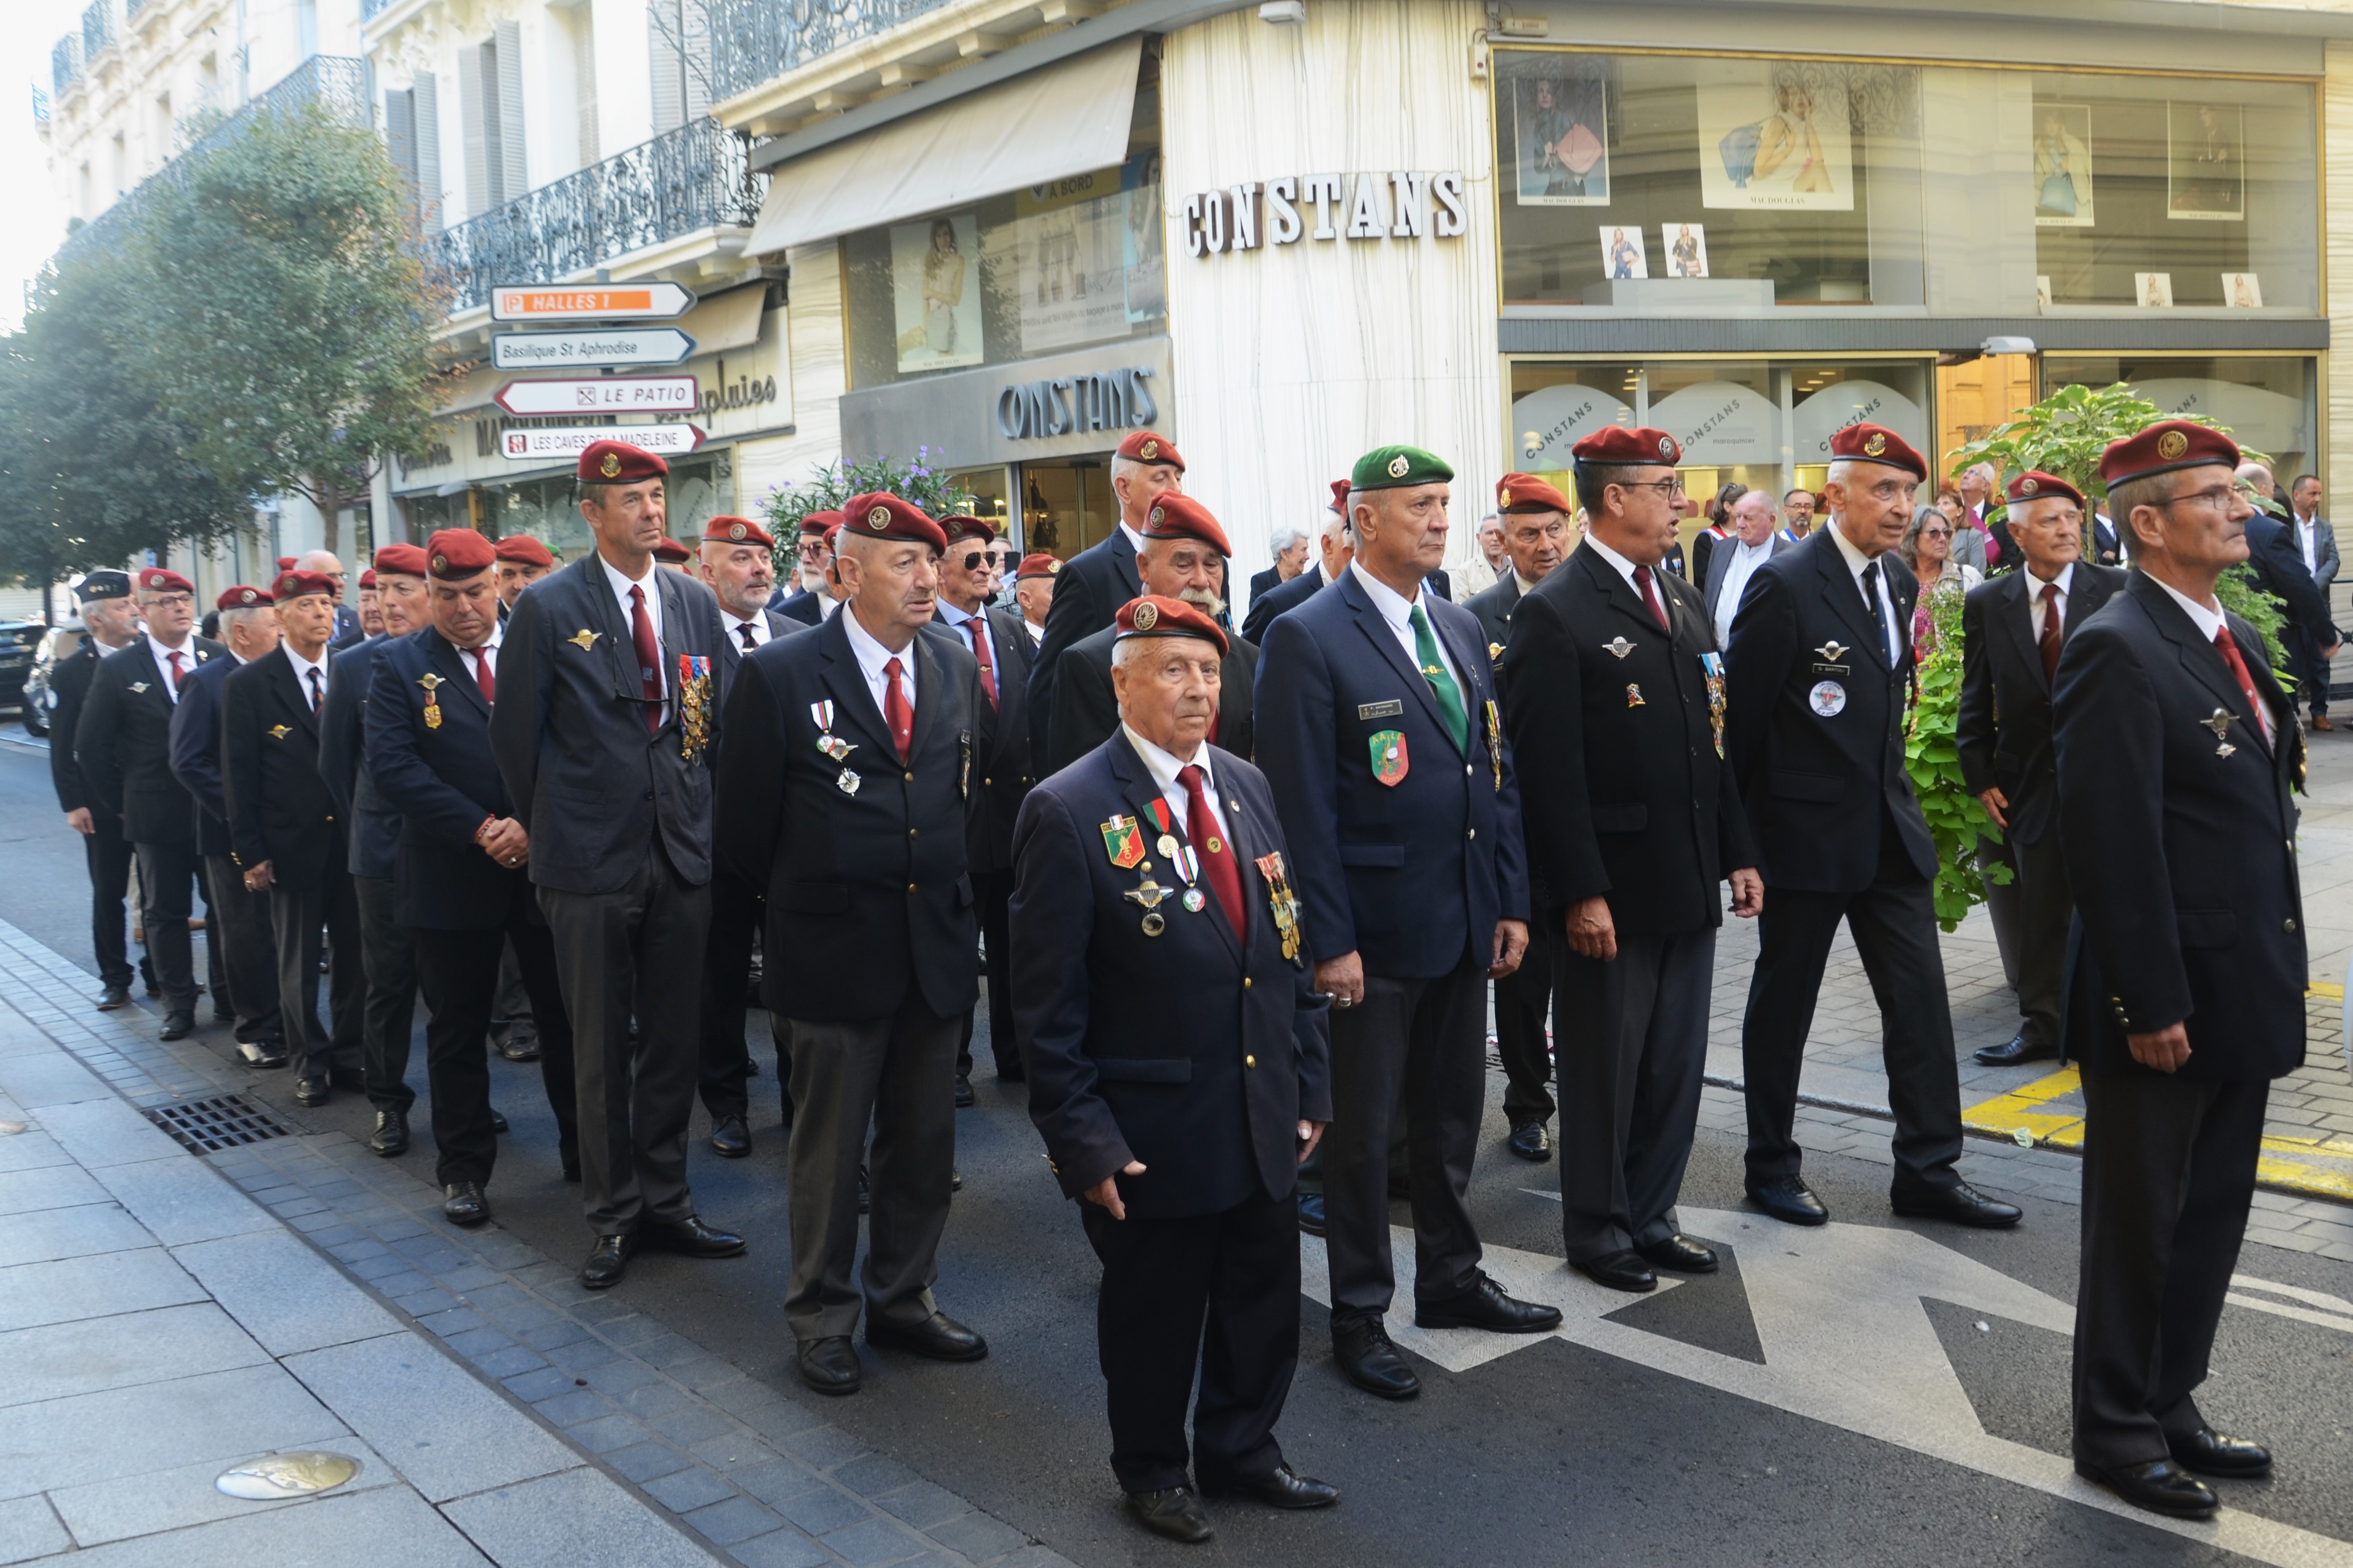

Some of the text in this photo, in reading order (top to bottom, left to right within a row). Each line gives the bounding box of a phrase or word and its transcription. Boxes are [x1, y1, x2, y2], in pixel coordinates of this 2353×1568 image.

[1061, 175, 1093, 196] BORD
[1183, 170, 1468, 257] CONSTANS
[533, 294, 597, 310] HALLES
[603, 294, 611, 308] 1
[503, 340, 637, 360] Basilique St Aphrodise
[604, 387, 686, 402] LE PATIO
[998, 365, 1158, 440] CONSTANS
[1525, 401, 1592, 460] CONSTANS
[533, 435, 551, 450] LES
[555, 434, 586, 449] CAVES
[619, 432, 678, 447] MADELEINE
[1713, 437, 1756, 446] maroquinier
